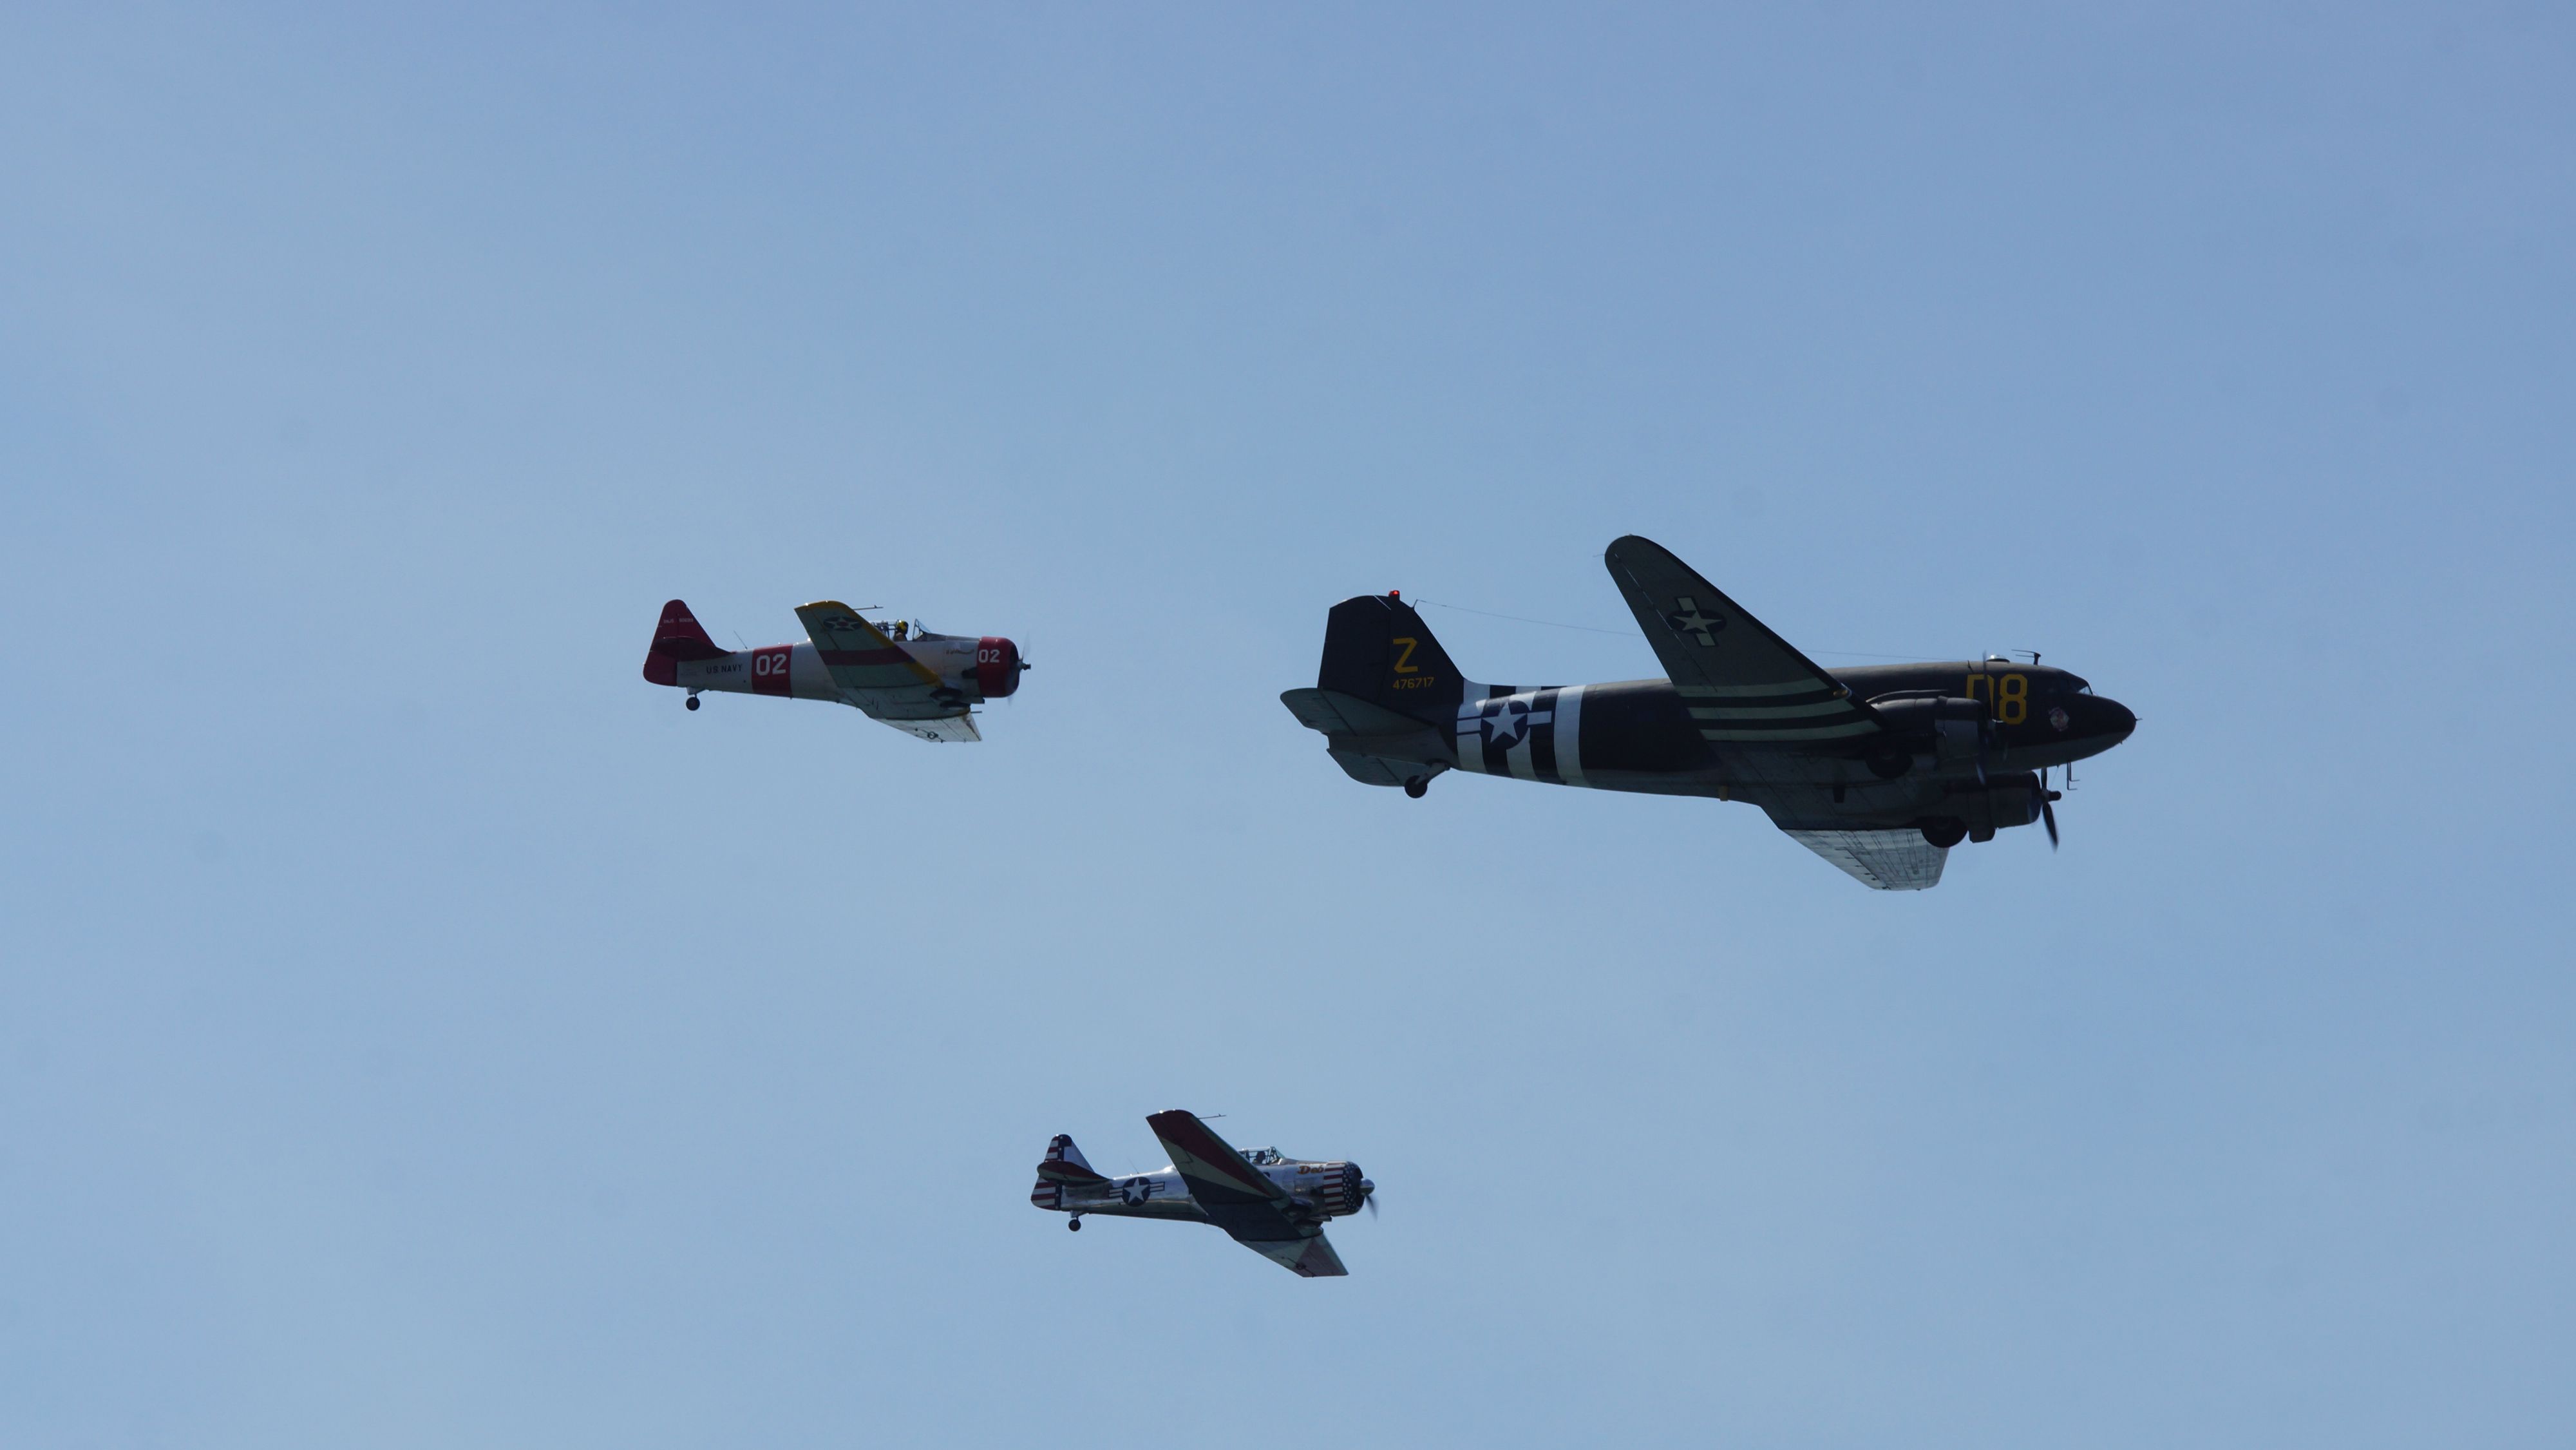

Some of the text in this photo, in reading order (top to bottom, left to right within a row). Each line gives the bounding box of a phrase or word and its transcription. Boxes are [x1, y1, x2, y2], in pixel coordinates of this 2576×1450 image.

[978, 649, 1000, 663] 02
[1393, 637, 1418, 673] Z
[721, 663, 743, 673] NAVY
[755, 653, 787, 676] 02
[1392, 676, 1435, 690] 476717
